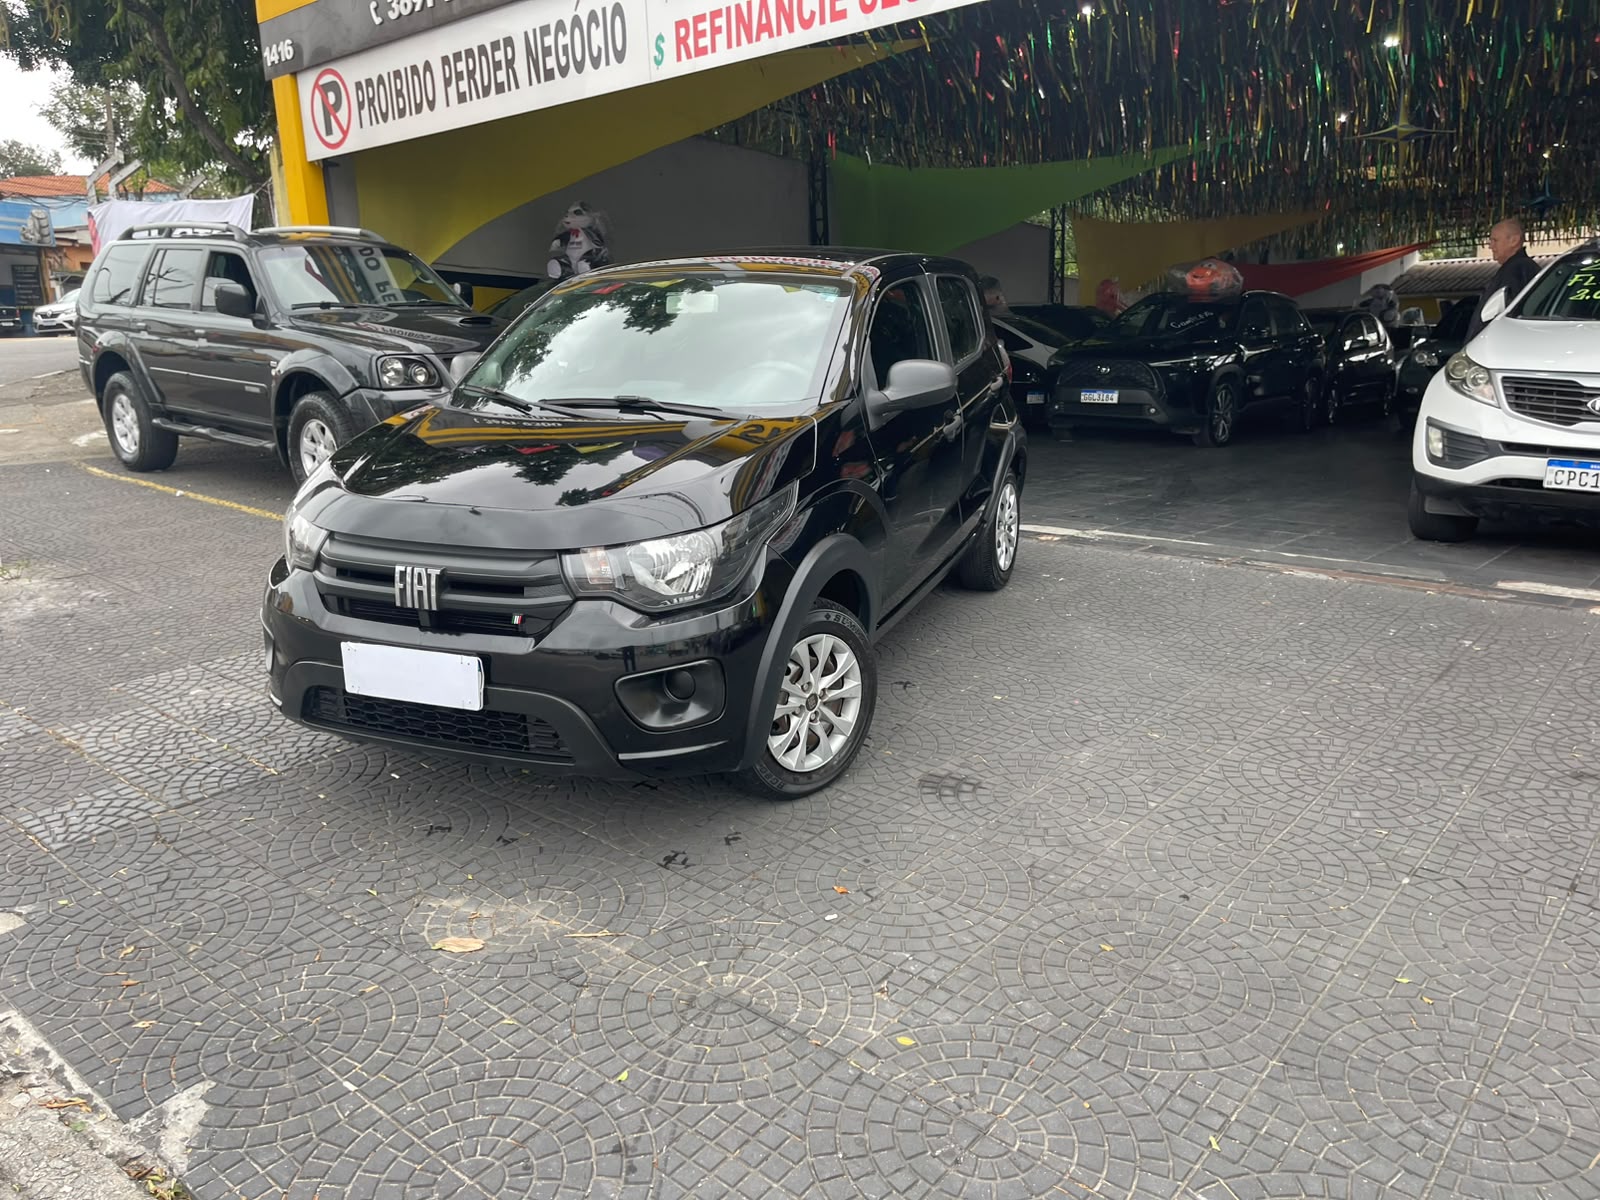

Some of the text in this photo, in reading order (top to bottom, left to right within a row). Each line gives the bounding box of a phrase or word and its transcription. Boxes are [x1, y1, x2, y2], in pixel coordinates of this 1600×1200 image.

[263, 39, 294, 67] 1416
[674, 0, 848, 62] REFINANCIE
[355, 0, 627, 129] PROIBIDO PERDER NEGÓCIO
[1554, 469, 1599, 488] CPC1
[395, 565, 440, 611] FIAT
